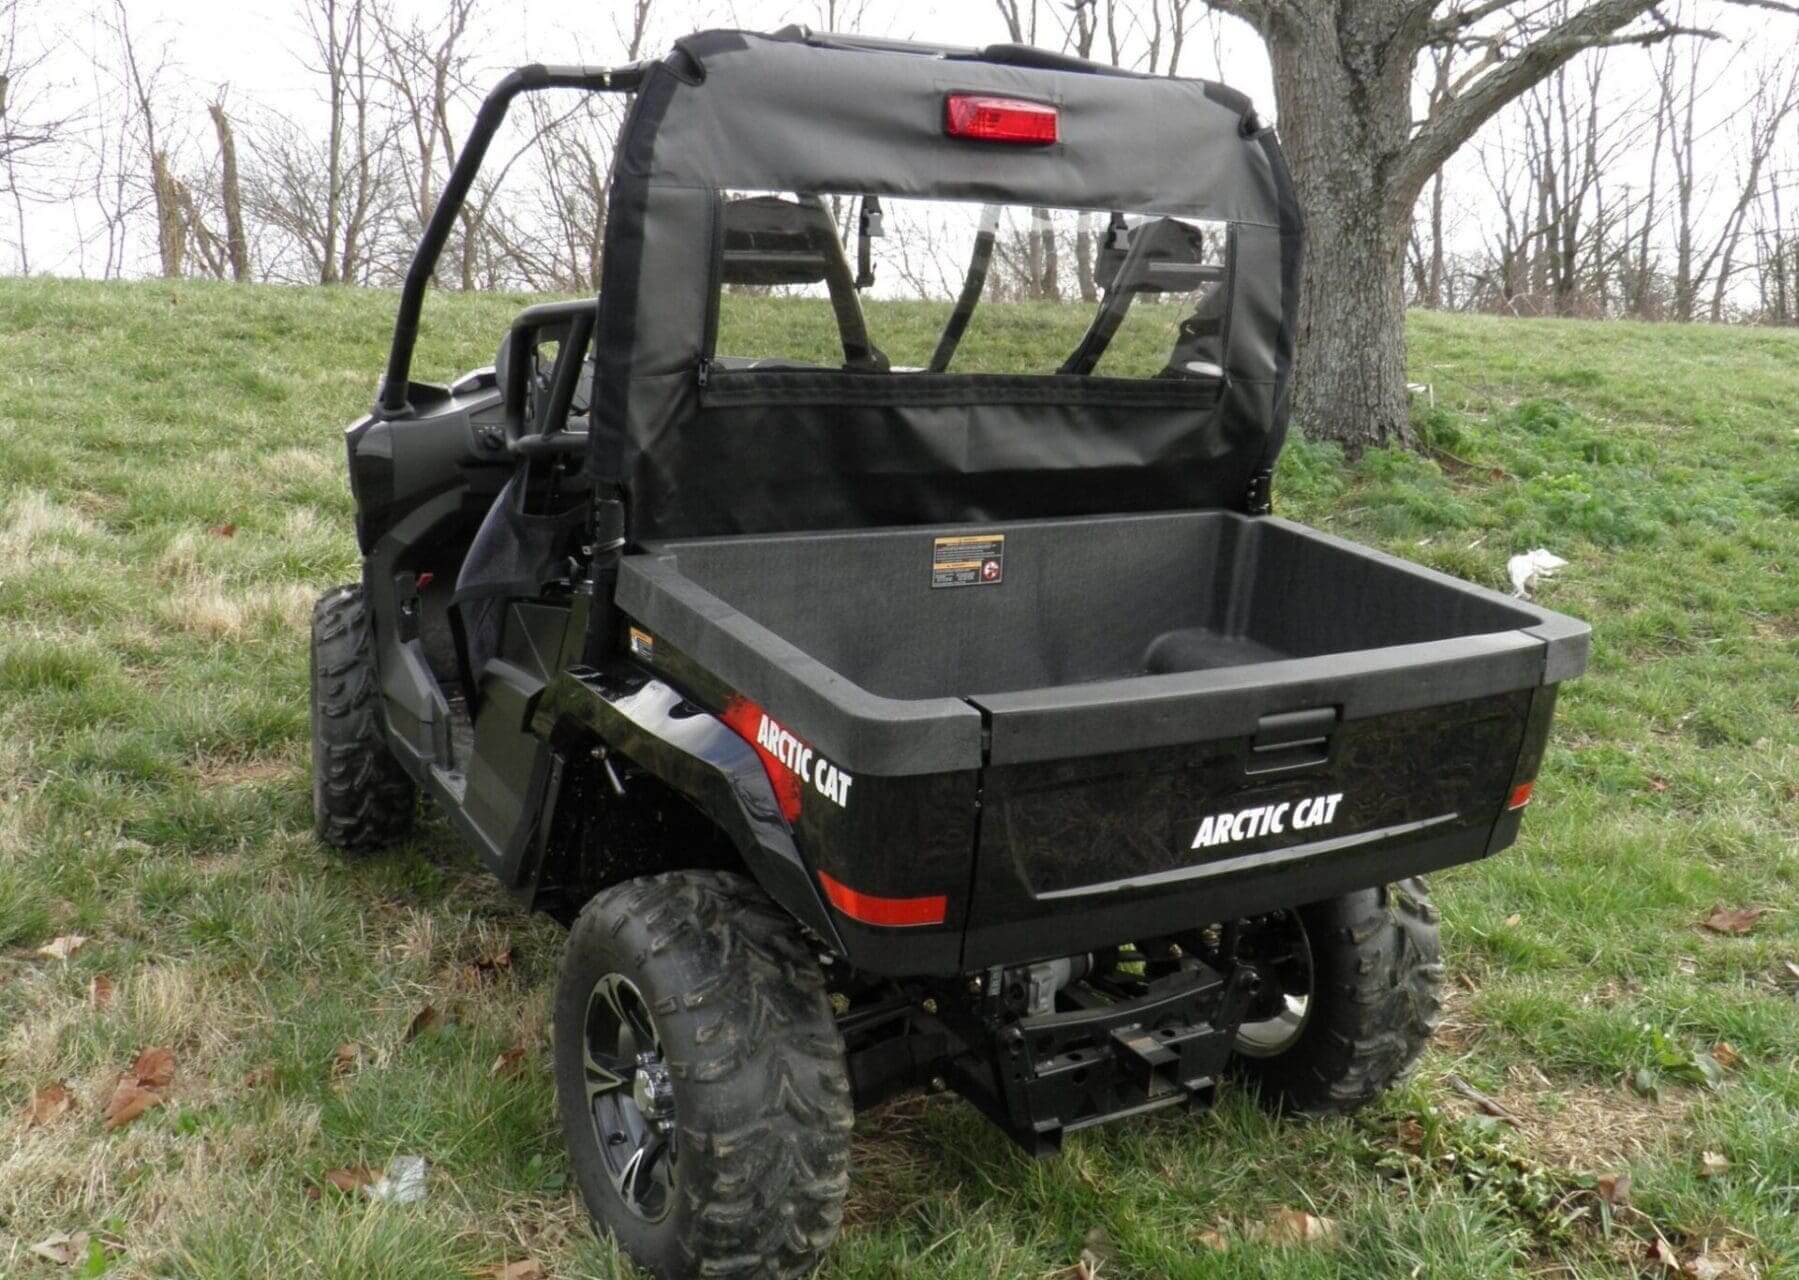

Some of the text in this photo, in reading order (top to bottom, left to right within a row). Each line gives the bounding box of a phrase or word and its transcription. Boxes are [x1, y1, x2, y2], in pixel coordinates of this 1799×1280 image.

[757, 714, 853, 808] ARCTIC CAT
[1190, 793, 1344, 849] ARCTIC CAT
